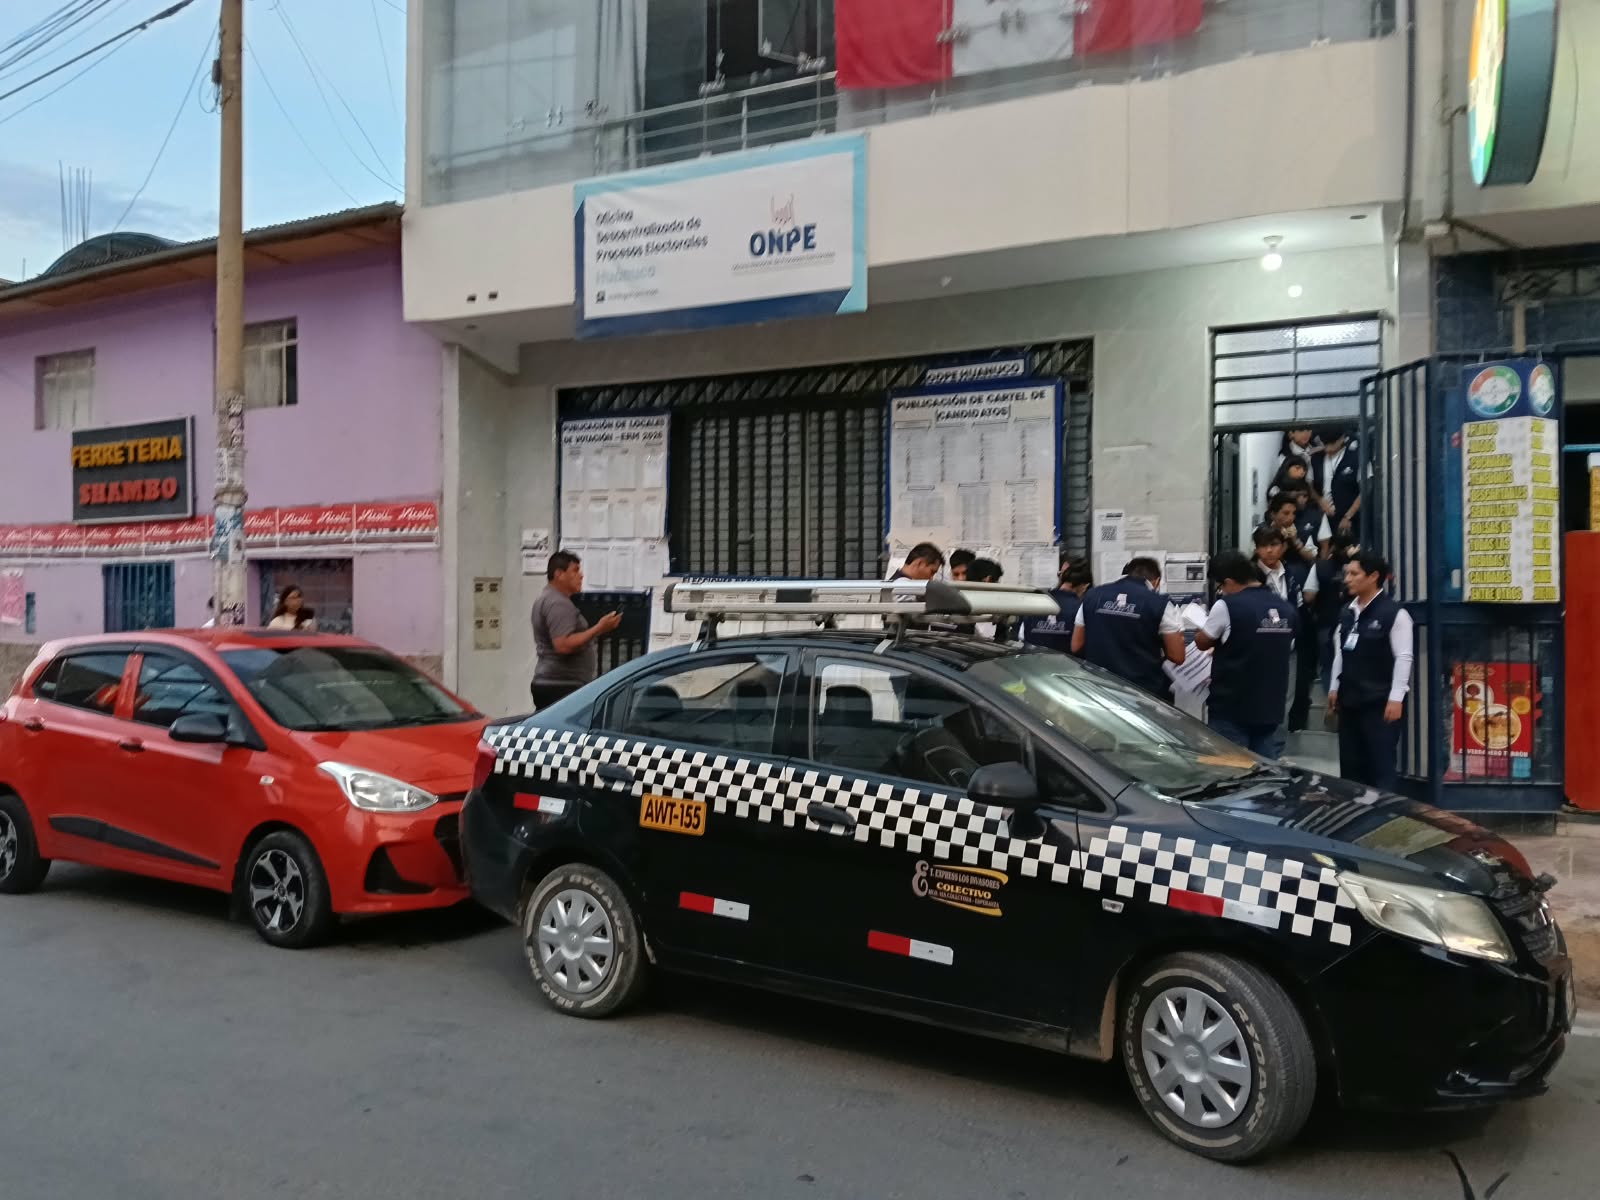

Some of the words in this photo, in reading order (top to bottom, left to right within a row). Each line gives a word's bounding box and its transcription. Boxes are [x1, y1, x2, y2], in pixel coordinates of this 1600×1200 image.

[749, 222, 817, 256] ONPE
[897, 394, 967, 410] PUBLICACIÓN
[970, 394, 984, 404] DE
[987, 392, 1027, 403] CARTEL
[1031, 390, 1046, 400] DE
[938, 405, 1008, 420] CANDIDATOS
[72, 435, 182, 468] FERRETERIA
[79, 477, 178, 505] SHAMBO
[644, 798, 701, 829] AWT-155
[936, 881, 992, 899] COLECTIVO
[959, 872, 969, 883] LOS
[1232, 1002, 1268, 1133] RYDANZ
